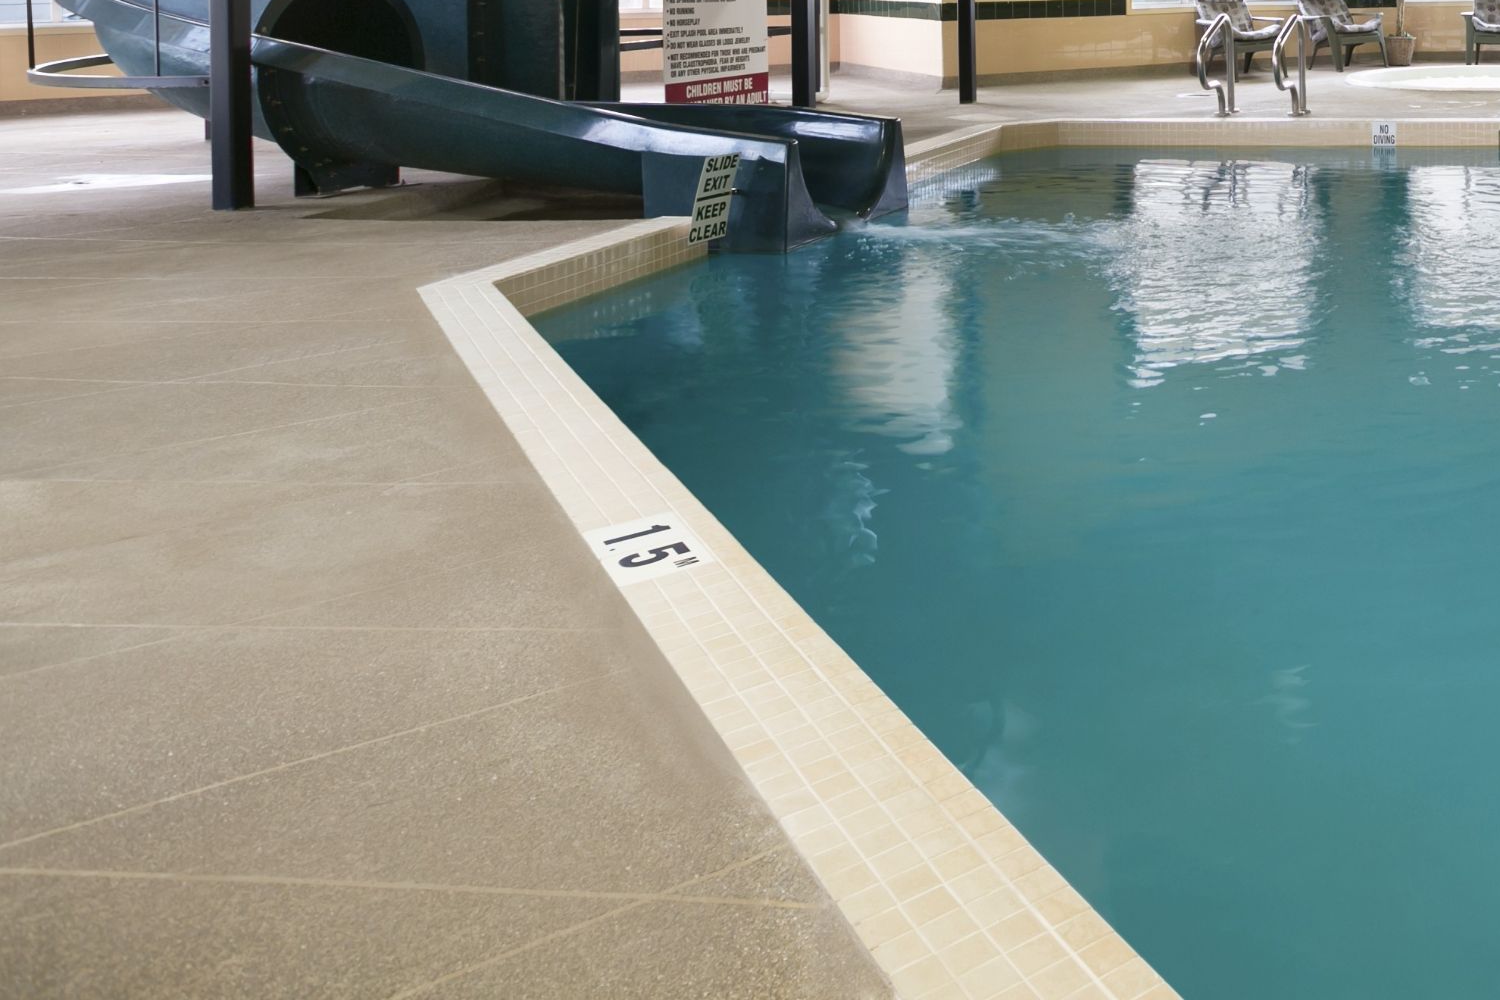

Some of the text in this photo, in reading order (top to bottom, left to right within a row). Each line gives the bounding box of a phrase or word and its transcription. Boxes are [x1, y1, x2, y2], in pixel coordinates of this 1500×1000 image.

[686, 78, 753, 98] CHILDREN MUST BE
[746, 90, 767, 104] ADULT
[1380, 124, 1389, 134] NO
[1374, 134, 1396, 144] DIVING
[706, 154, 739, 173] SLIDE
[703, 174, 731, 193] EXIT
[696, 201, 727, 222] KEEP
[688, 221, 727, 243] CLEAR
